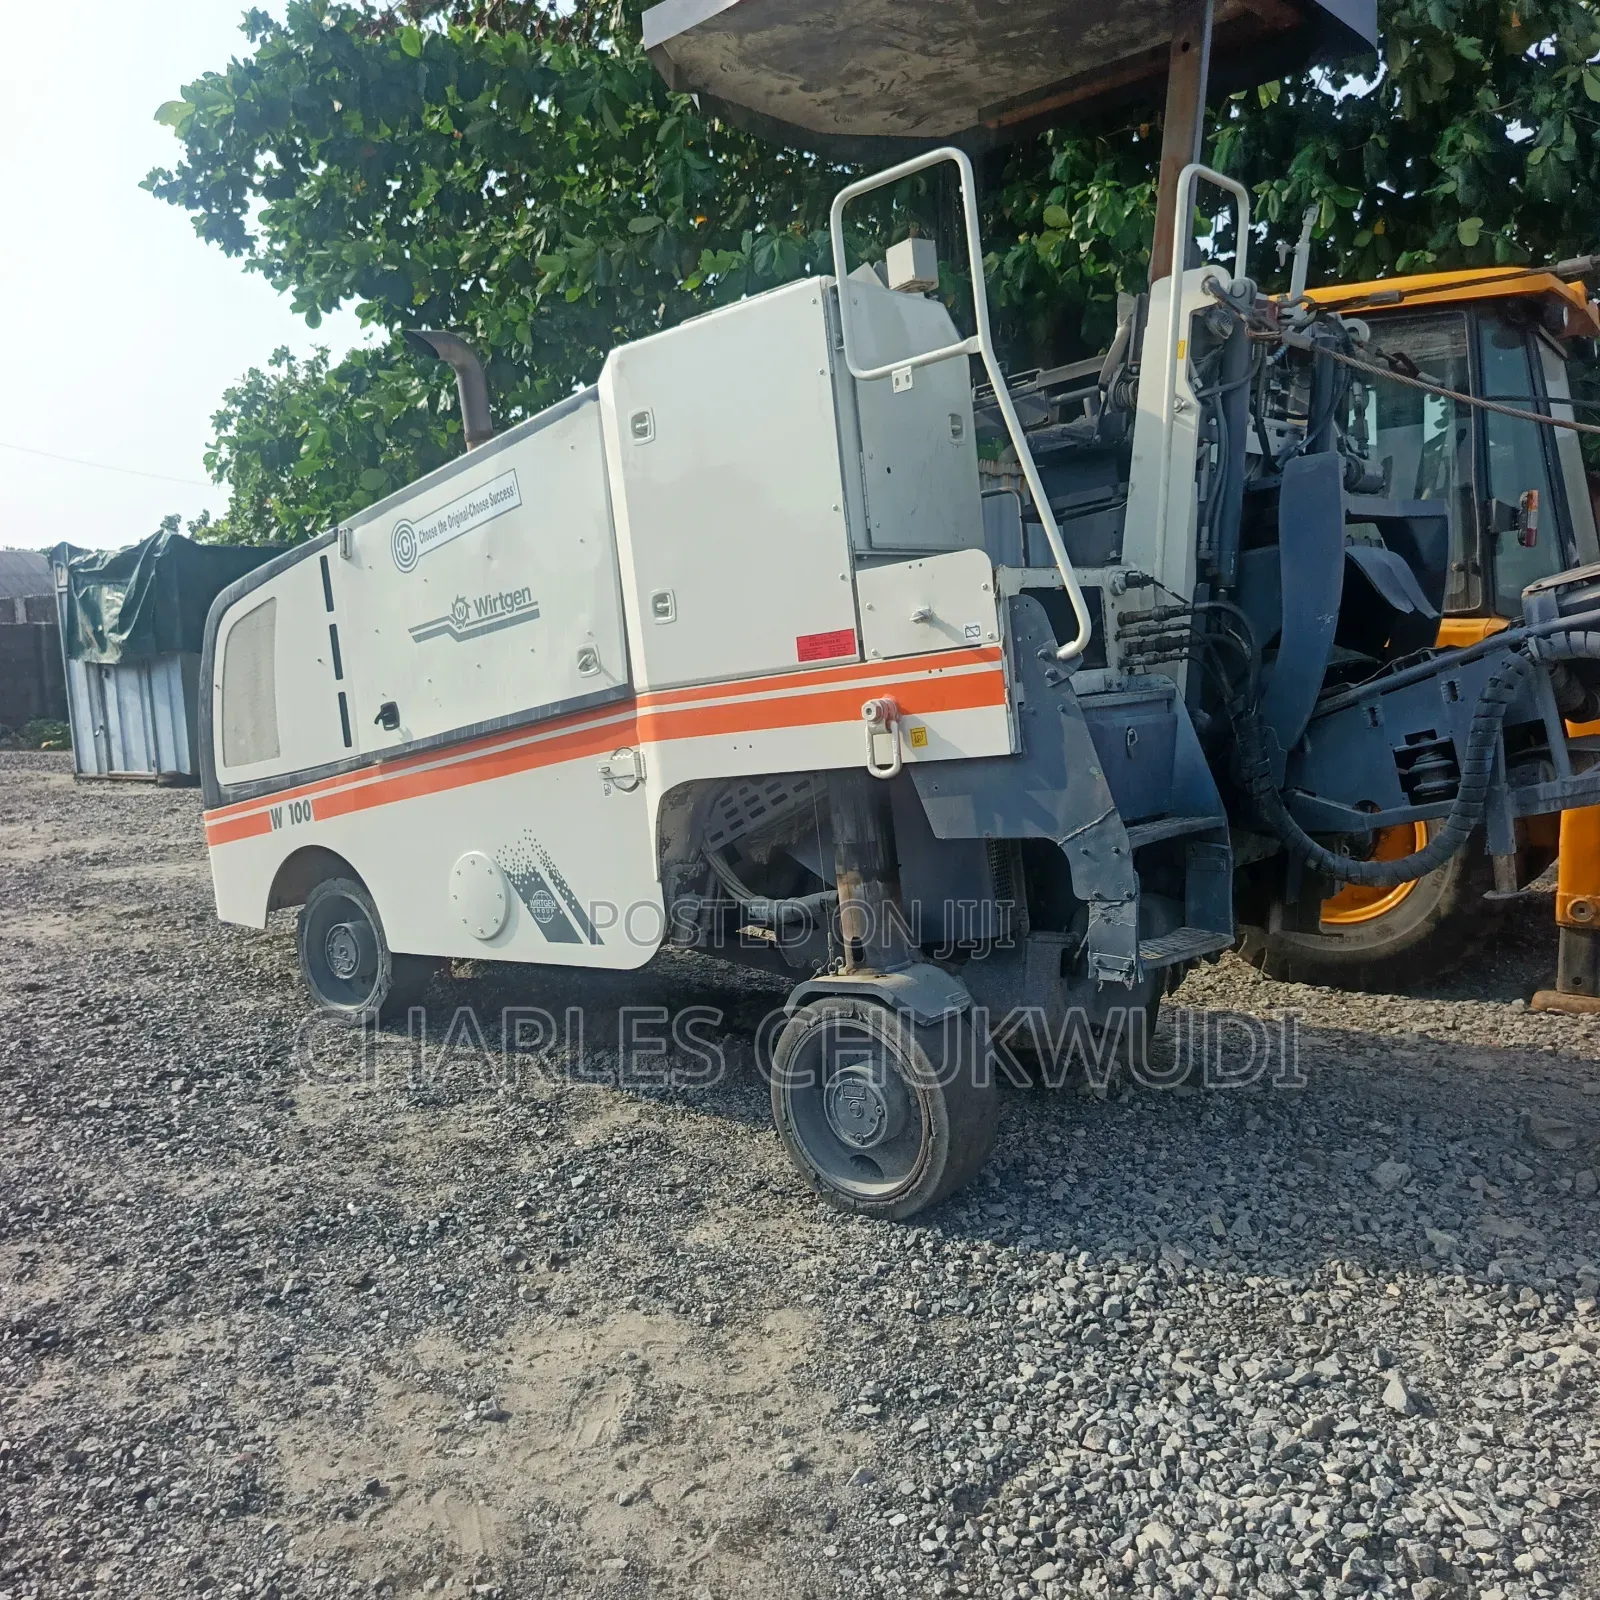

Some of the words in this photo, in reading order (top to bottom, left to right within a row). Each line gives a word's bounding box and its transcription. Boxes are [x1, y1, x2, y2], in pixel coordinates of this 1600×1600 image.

[418, 526, 438, 544] Choose
[437, 520, 448, 534] the
[488, 480, 517, 507] Success!
[473, 586, 532, 618] Wirtgen
[270, 806, 283, 830] W
[288, 799, 312, 826] 100
[530, 899, 556, 908] WIRTGEN
